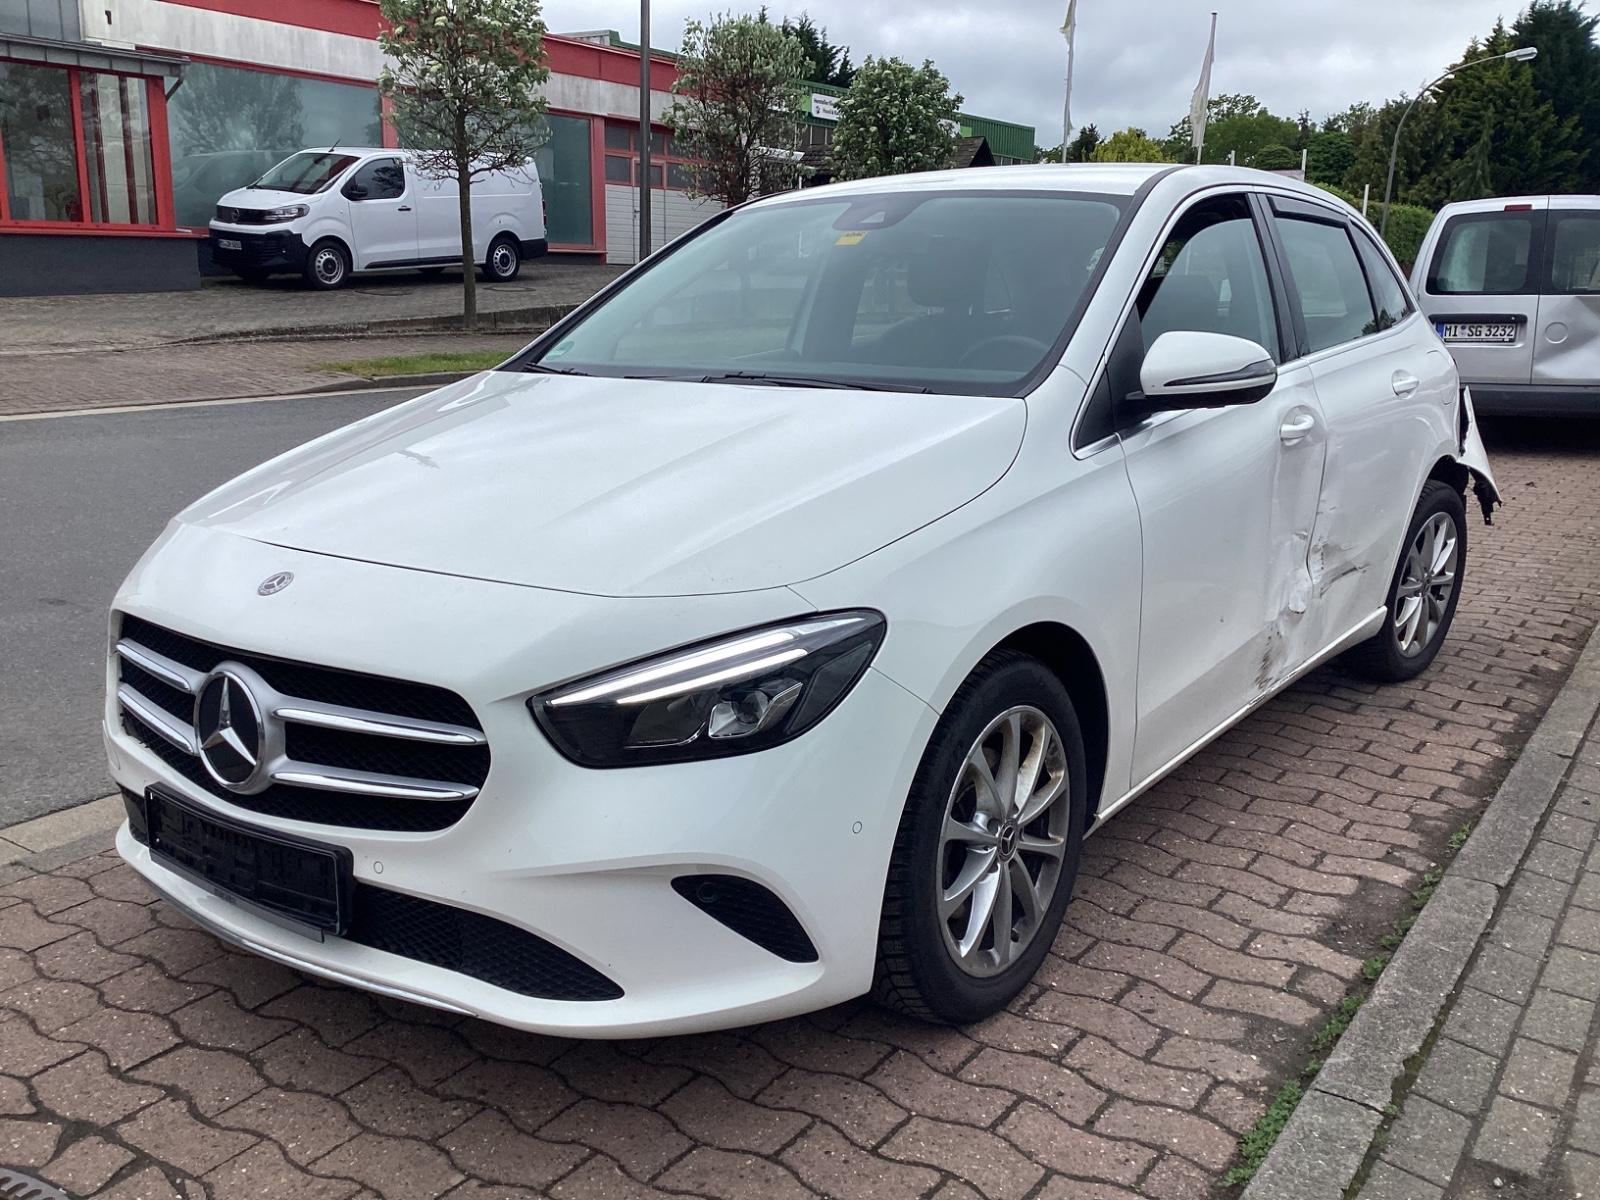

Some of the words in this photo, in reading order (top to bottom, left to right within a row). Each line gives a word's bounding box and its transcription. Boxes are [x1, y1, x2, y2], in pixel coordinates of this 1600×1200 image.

[1444, 325, 1458, 337] MI
[1467, 325, 1482, 337] SG
[1485, 325, 1514, 337] 3232
